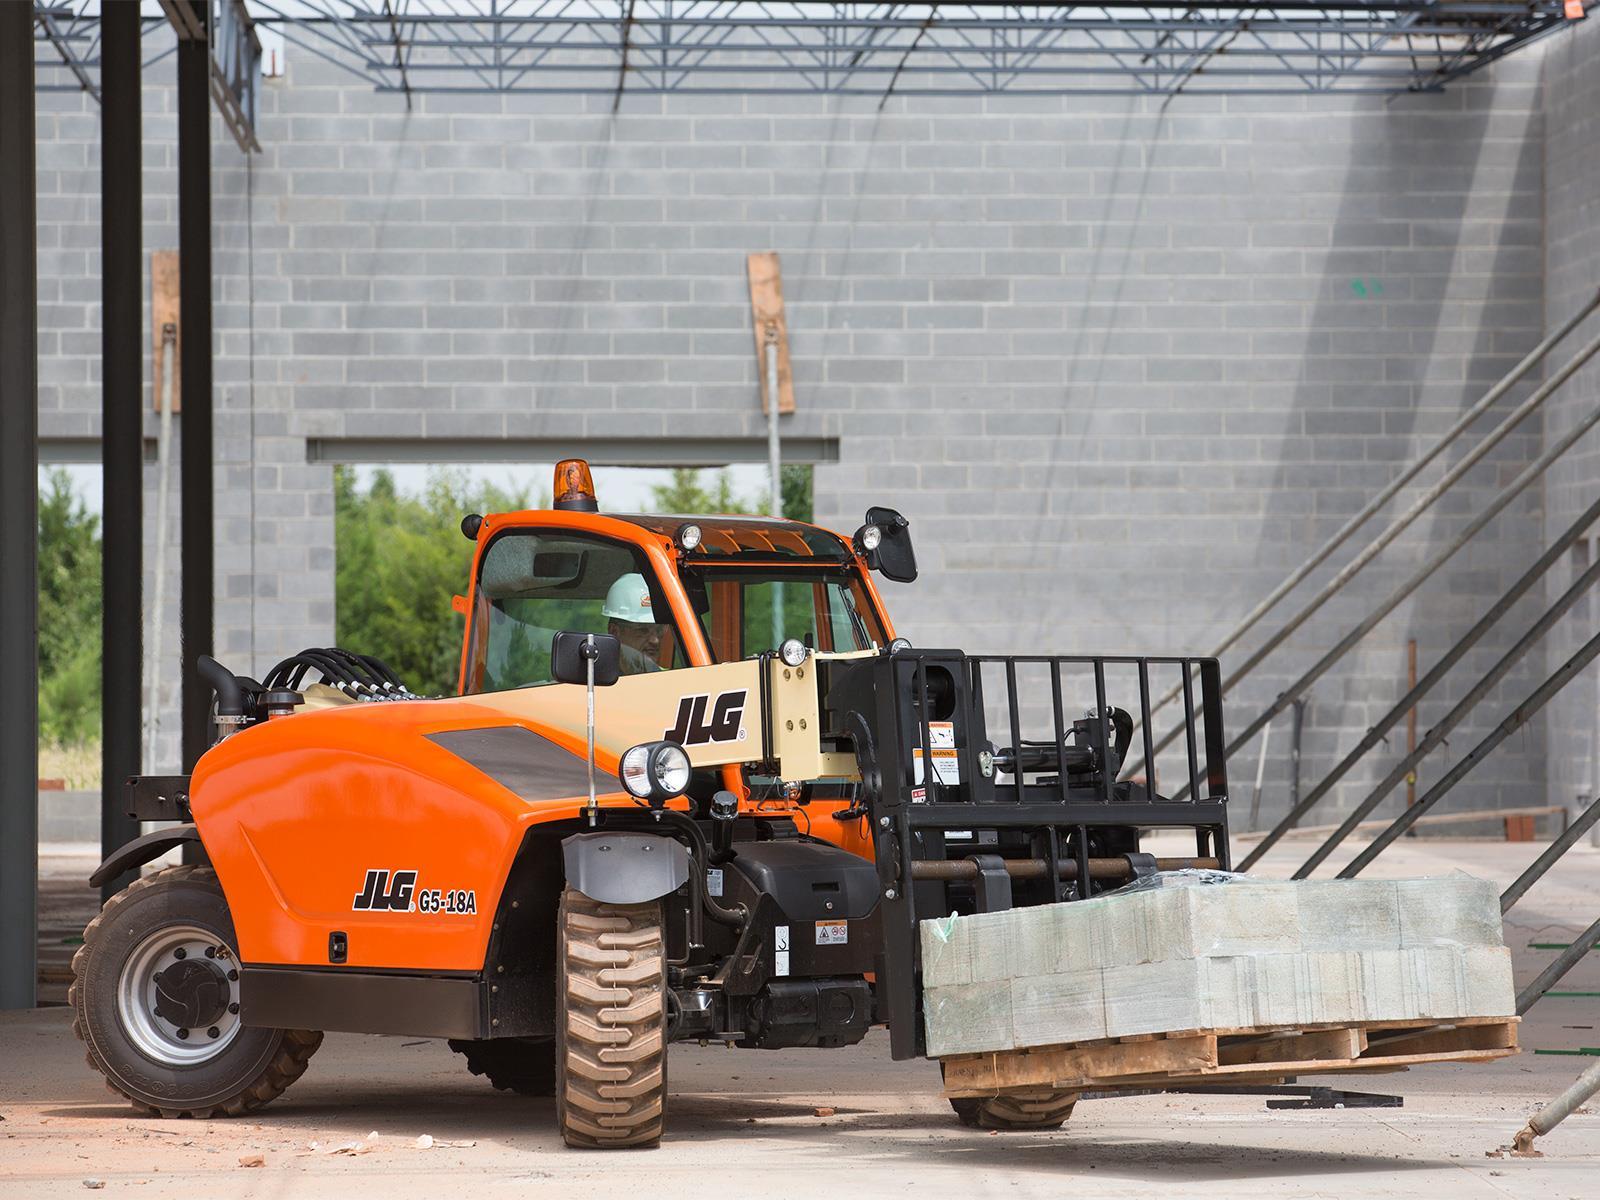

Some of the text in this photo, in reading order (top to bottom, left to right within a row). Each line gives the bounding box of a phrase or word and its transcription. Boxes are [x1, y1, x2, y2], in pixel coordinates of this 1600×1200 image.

[664, 689, 748, 746] JLG
[353, 869, 476, 913] JLG G5-18A
